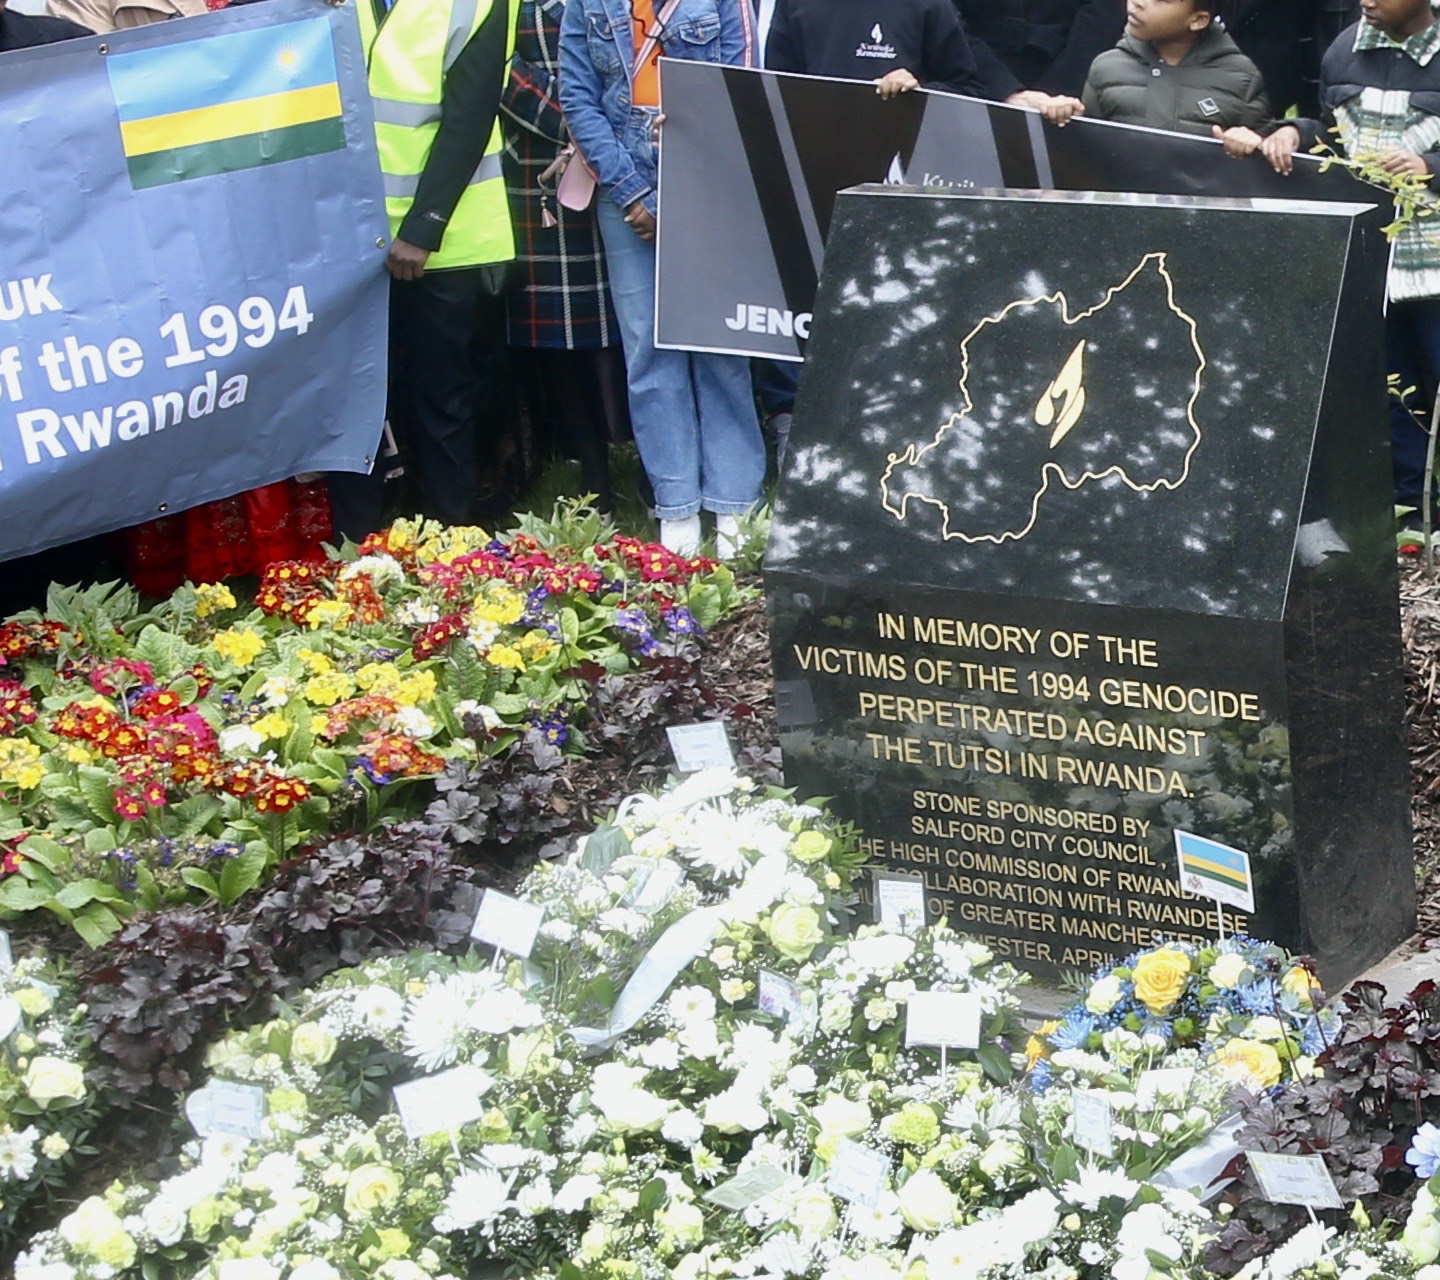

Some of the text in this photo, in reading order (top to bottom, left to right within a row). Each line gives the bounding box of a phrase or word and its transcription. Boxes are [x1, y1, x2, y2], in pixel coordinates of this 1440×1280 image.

[37, 323, 145, 392] the
[160, 284, 313, 369] 1994
[17, 370, 249, 464] Rwanda
[878, 613, 1159, 668] IN MEMORY OF THE
[793, 645, 1261, 722] VICTIMS OF THE 1994 GENOCIDE
[858, 692, 1206, 757] PERPETRATED AGAINST
[866, 732, 1196, 799] THE TUTSI IN RWANDA.
[910, 815, 1006, 846] SALFORD
[1010, 827, 1056, 853] CITY
[912, 790, 1151, 839] STONE SPONSORED BY
[858, 837, 886, 858] HE
[891, 841, 940, 865] HIGH
[944, 849, 1077, 885] COMMISSION
[1083, 867, 1112, 889] OF
[927, 897, 955, 918] OF
[960, 902, 1057, 934] GREATER
[1068, 893, 1122, 917] WITH
[1127, 899, 1248, 935] RWANDESE
